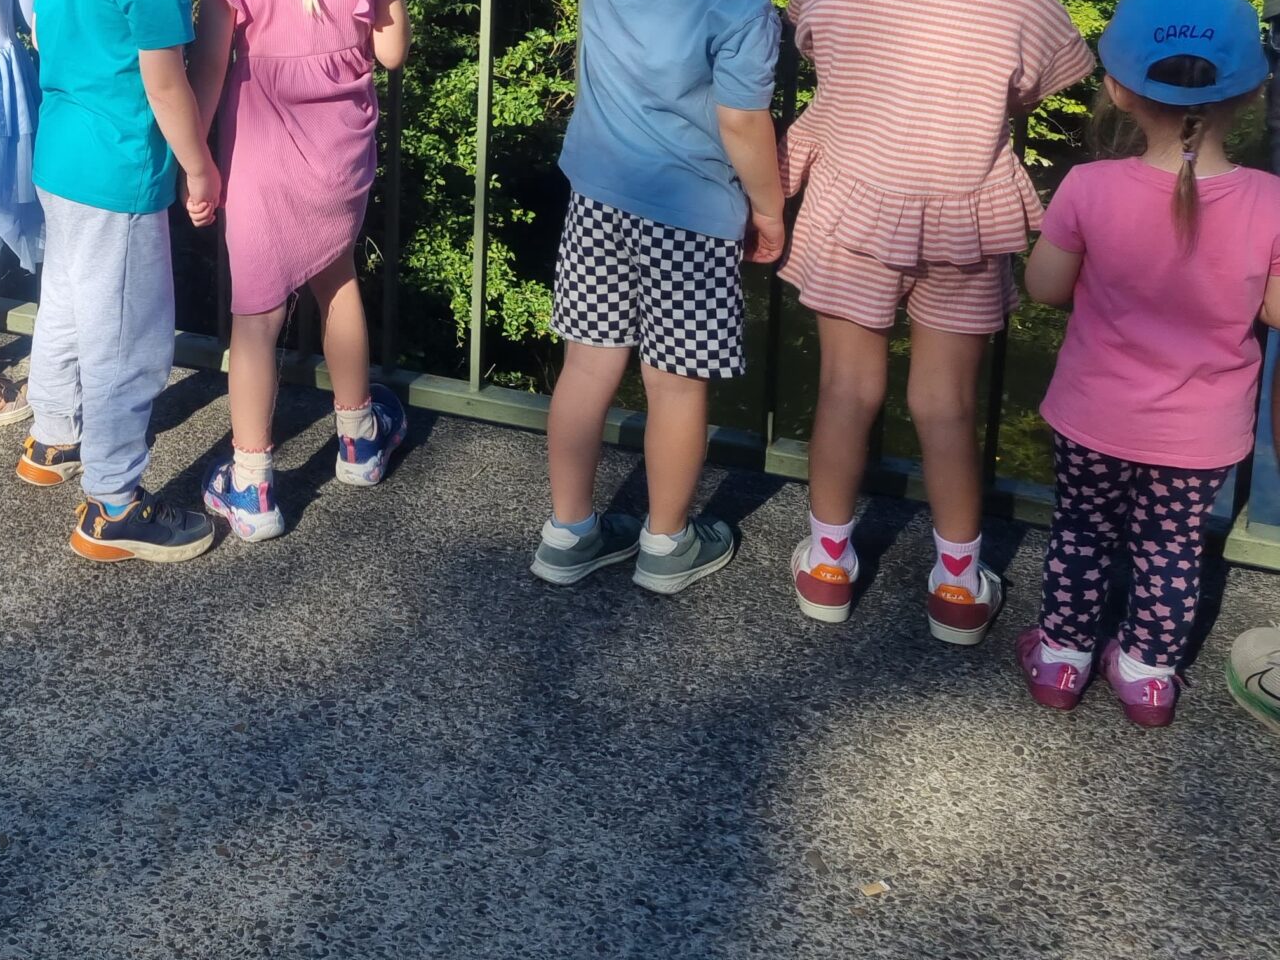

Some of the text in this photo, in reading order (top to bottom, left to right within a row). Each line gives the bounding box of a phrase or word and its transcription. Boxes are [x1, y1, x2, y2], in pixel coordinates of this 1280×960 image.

[1153, 24, 1216, 44] CARLA
[820, 571, 844, 581] VEJA
[941, 592, 965, 601] VEJA
